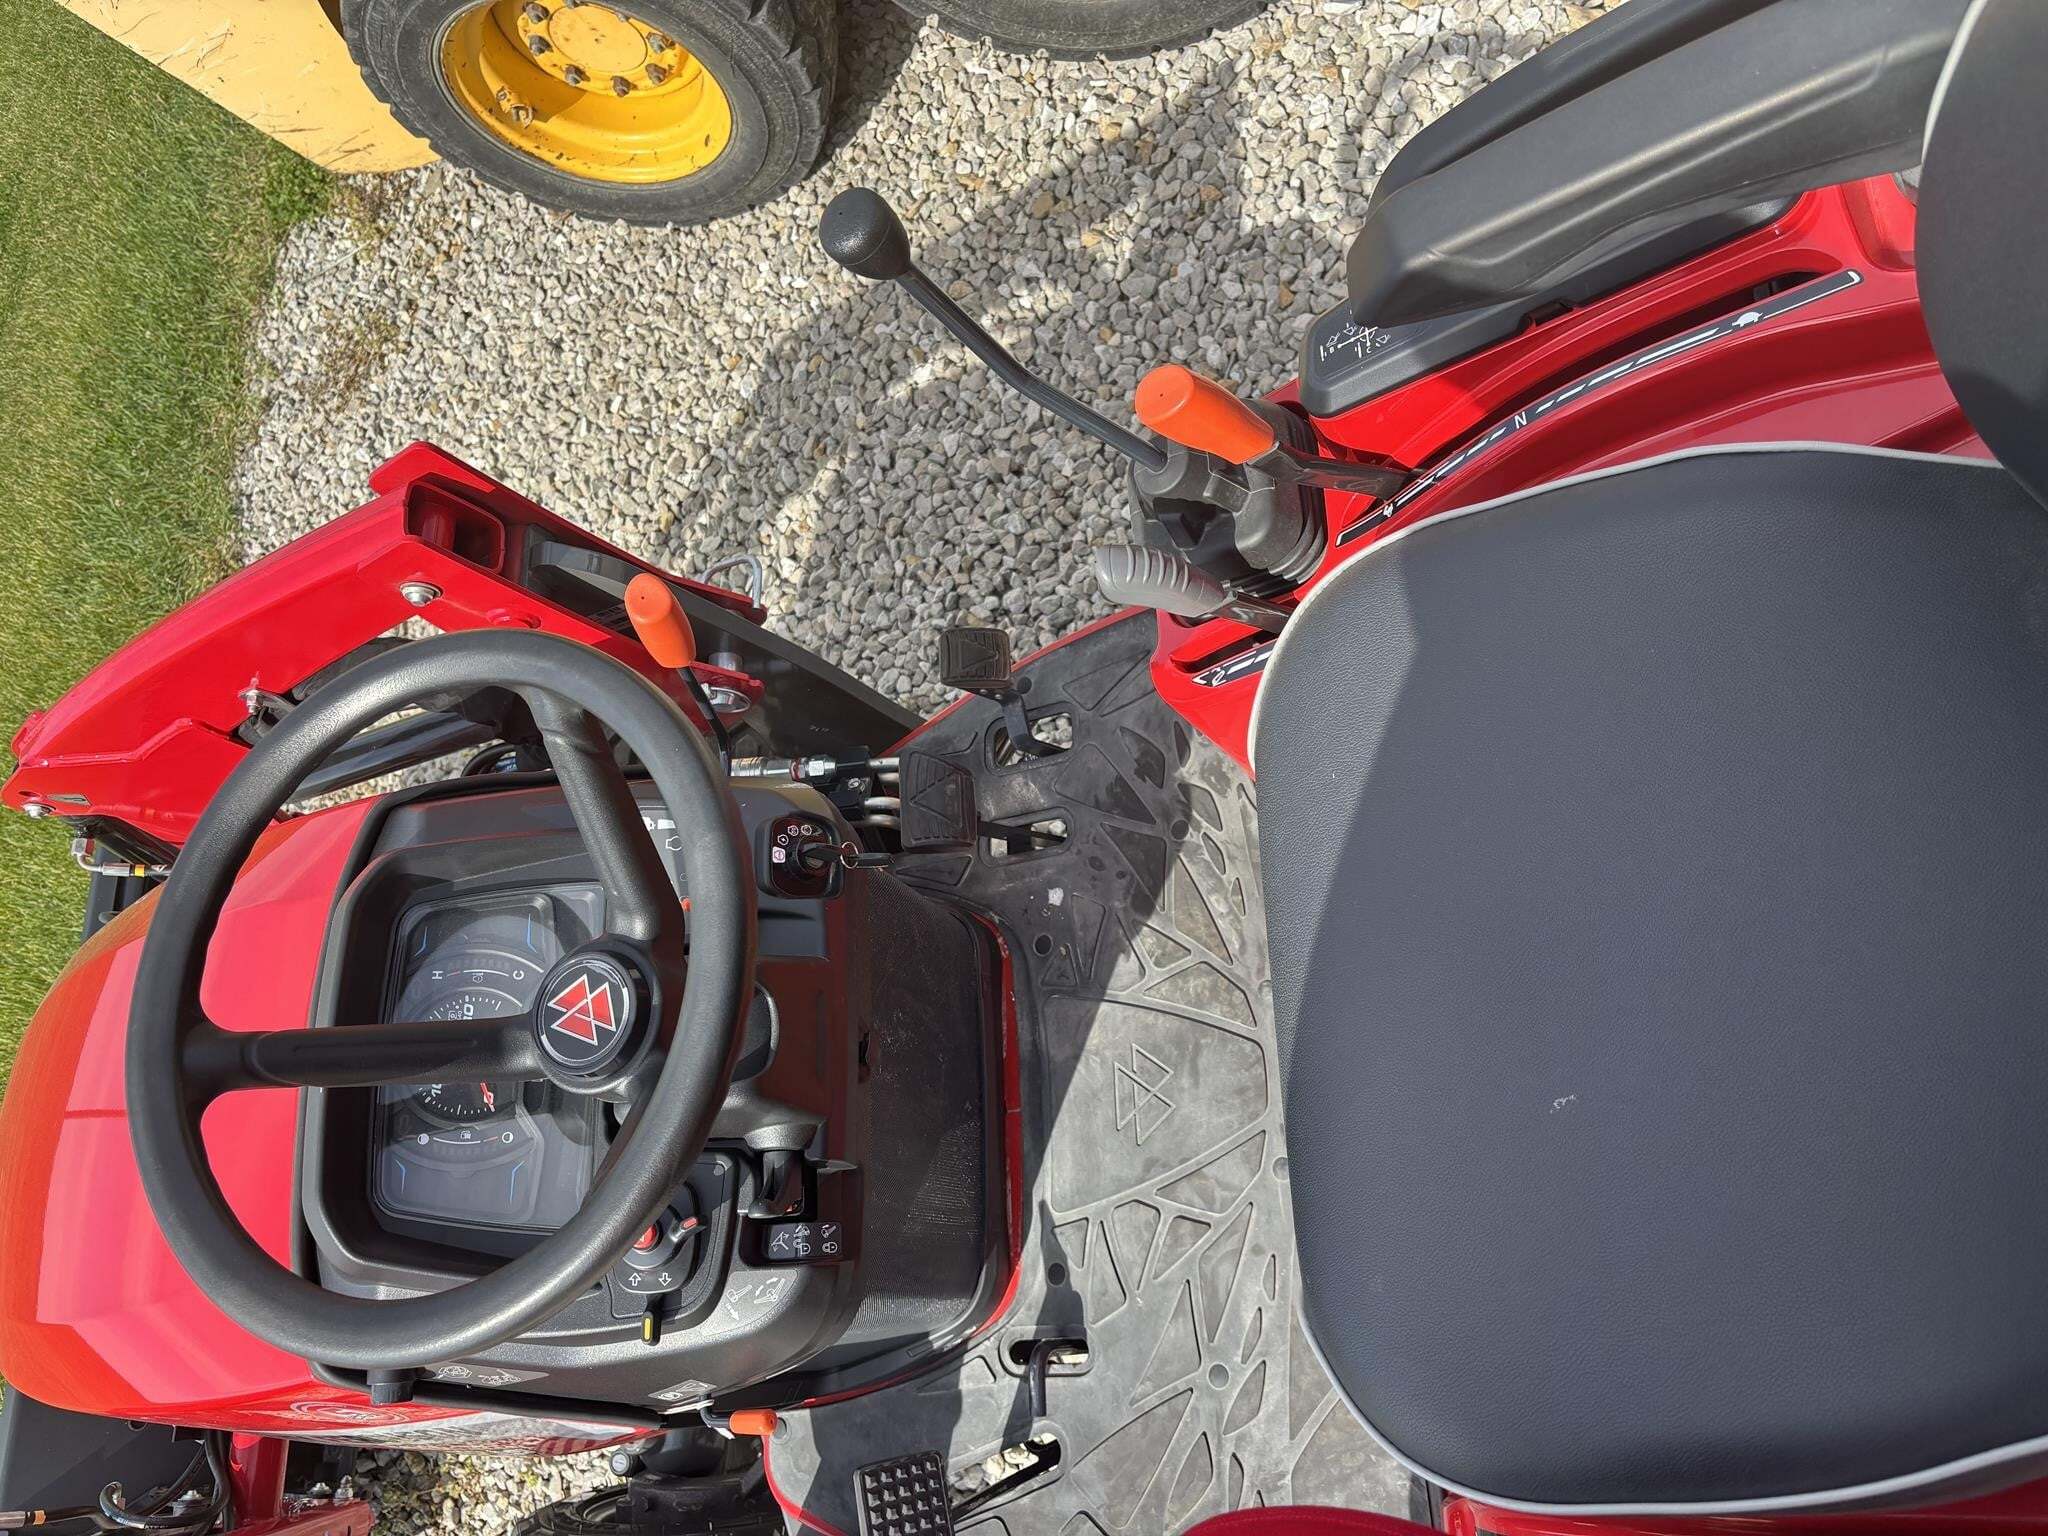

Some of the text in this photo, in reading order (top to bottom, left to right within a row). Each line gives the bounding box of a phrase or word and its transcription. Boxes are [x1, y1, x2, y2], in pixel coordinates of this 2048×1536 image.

[1514, 411, 1527, 429] N
[431, 970, 444, 980] H
[512, 970, 525, 981] C
